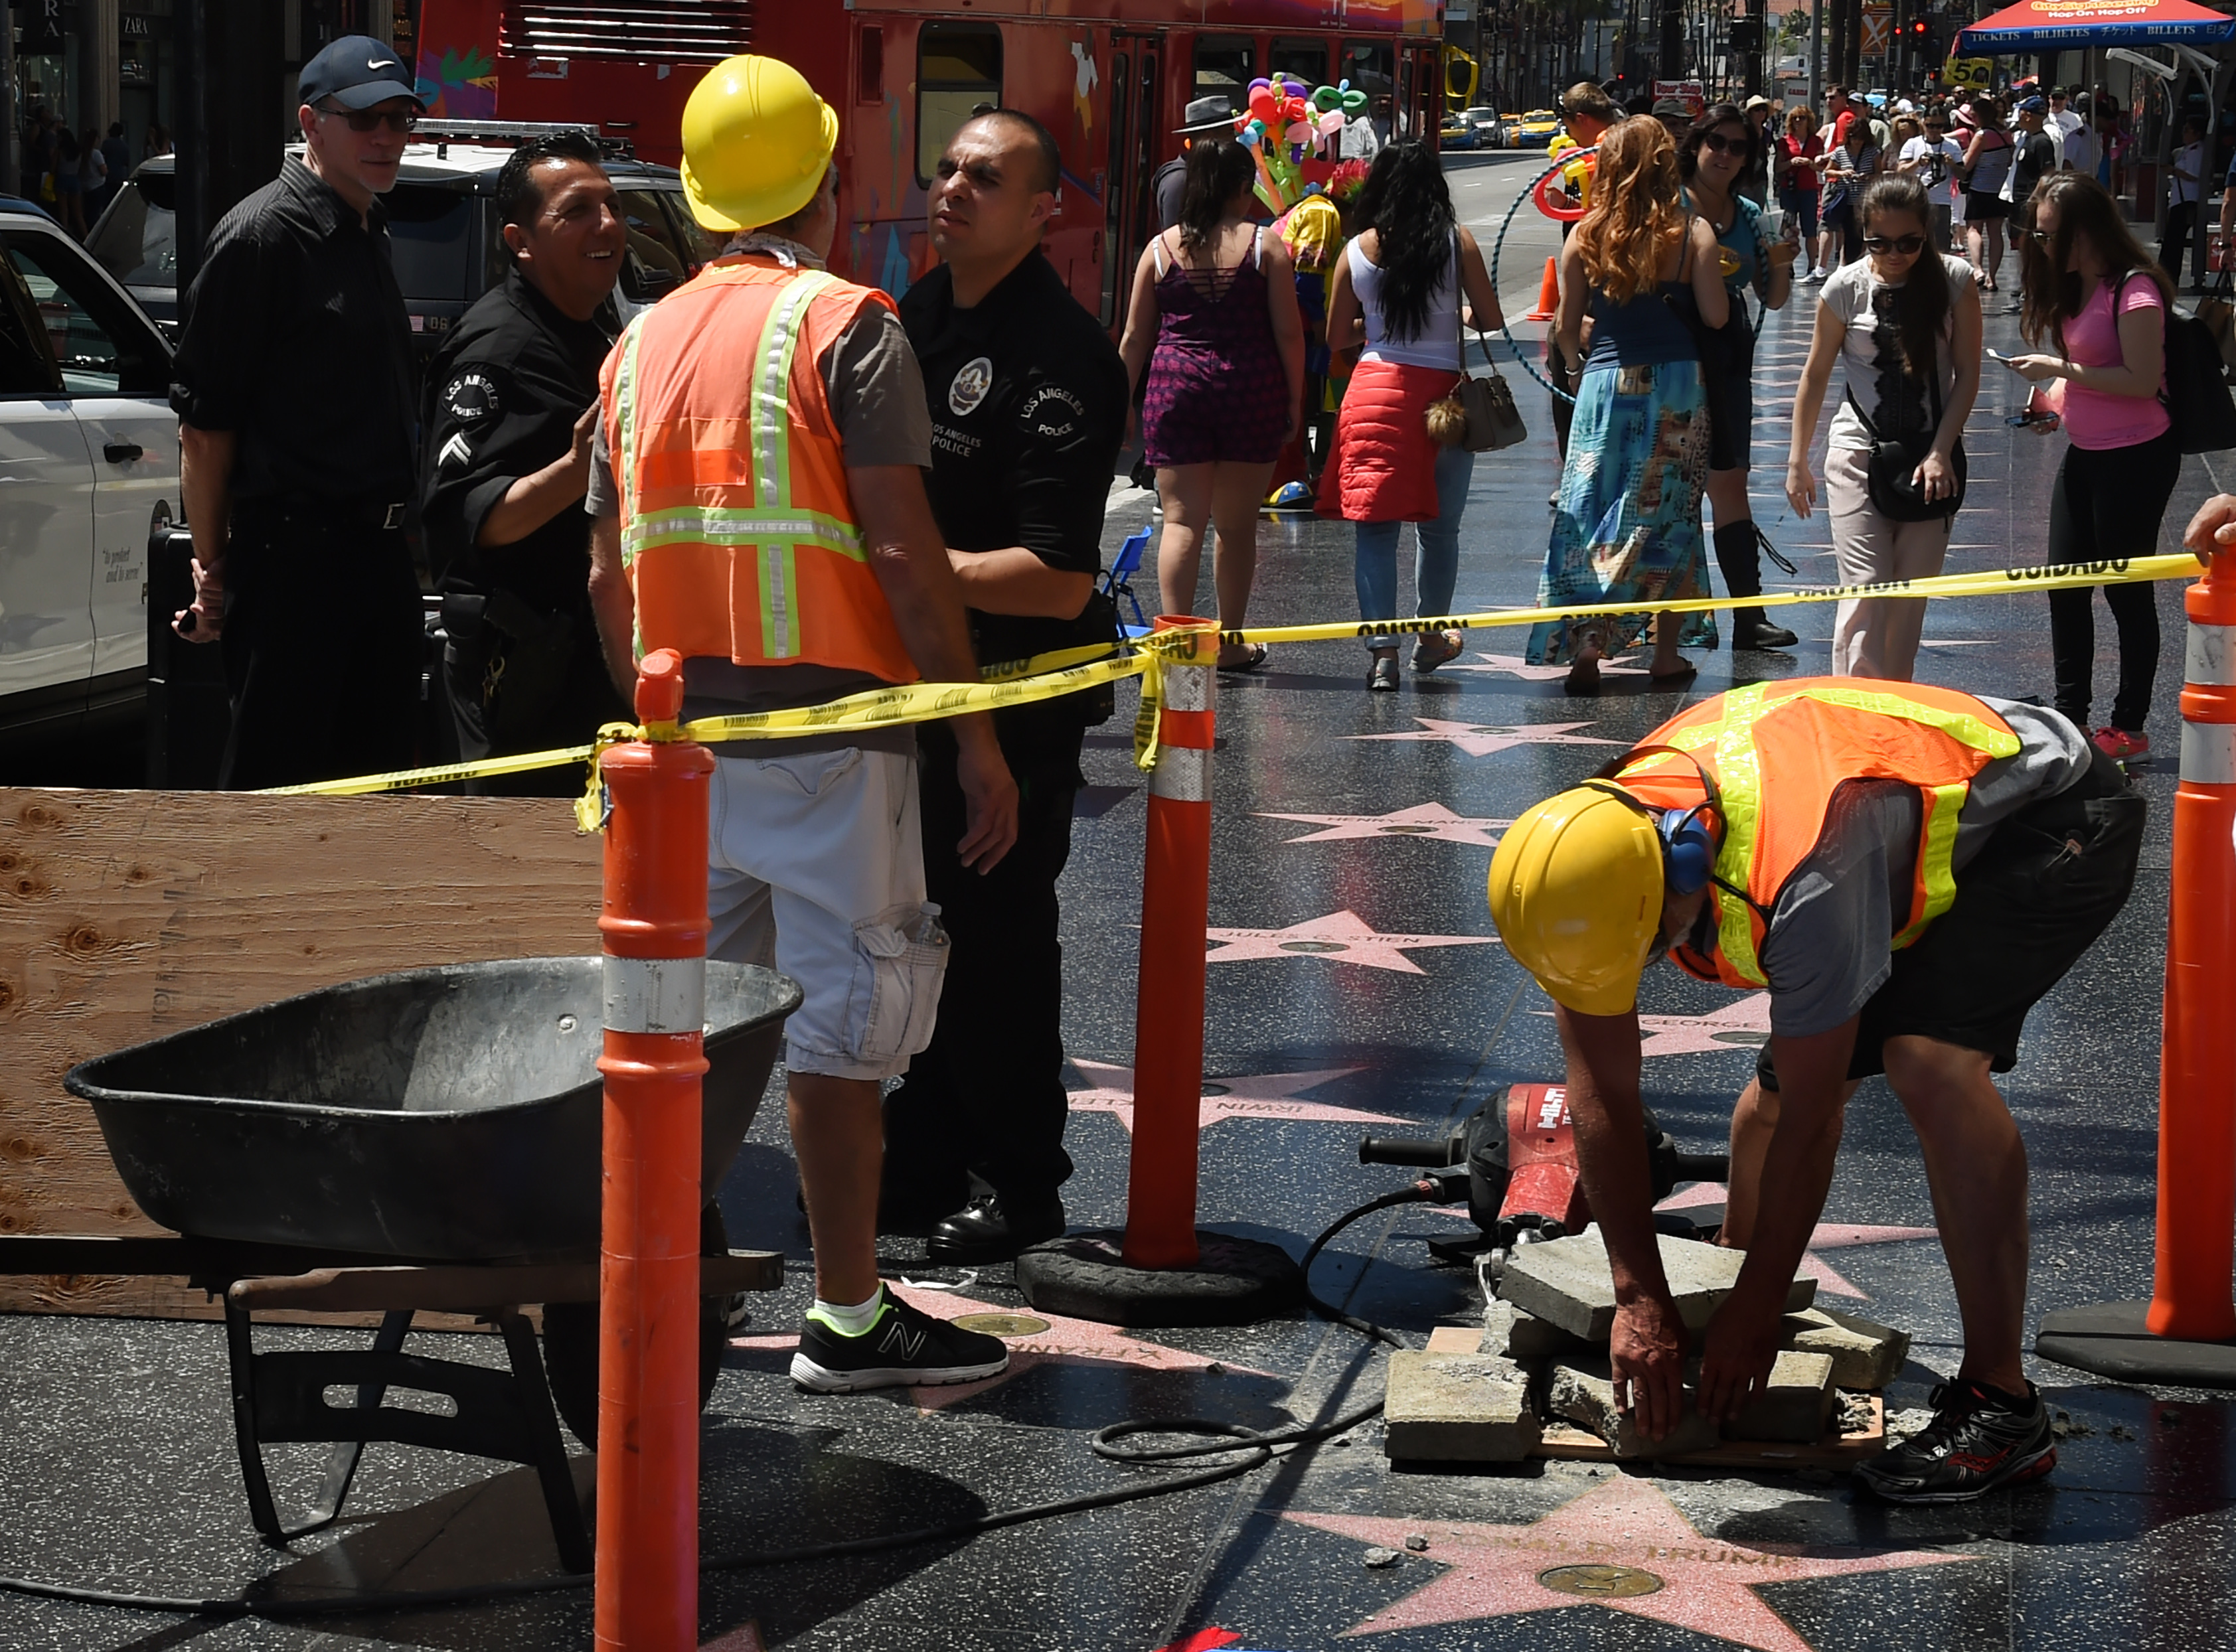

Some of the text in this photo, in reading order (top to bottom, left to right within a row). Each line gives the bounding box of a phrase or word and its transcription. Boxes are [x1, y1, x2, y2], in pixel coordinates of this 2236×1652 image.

[124, 17, 148, 34] ZARA
[2147, 25, 2196, 35] BILLETS
[1970, 31, 2020, 42] TICKETS
[445, 374, 499, 410] LOS ANGELES
[451, 403, 483, 417] POLICE
[1020, 388, 1085, 419] LOS ANGELES
[944, 427, 982, 448] ANGELES
[1038, 423, 1074, 436] POLICE
[931, 435, 973, 457] POLICE
[1220, 931, 1299, 939] JULES
[1641, 1018, 1761, 1029] GEORGE
[1216, 1101, 1304, 1113] IRWIN
[1537, 1088, 1567, 1129] HILTI
[1006, 1342, 1128, 1358] FRANK
[1638, 1544, 1798, 1567] TRUMP
